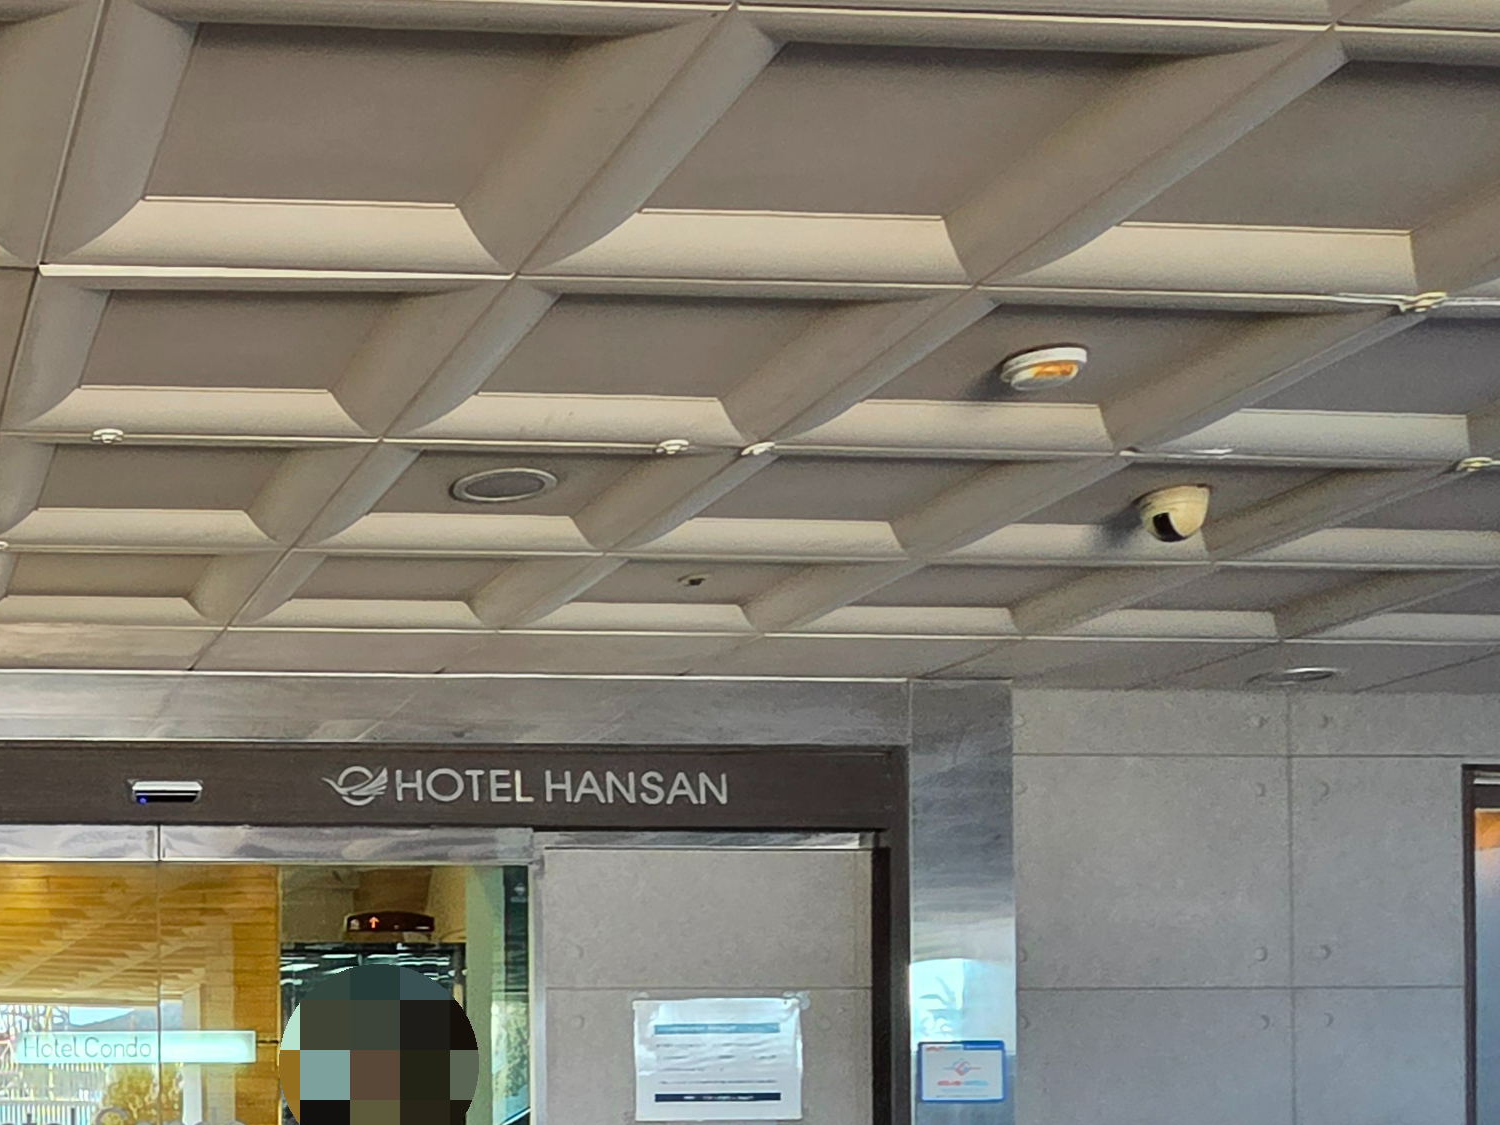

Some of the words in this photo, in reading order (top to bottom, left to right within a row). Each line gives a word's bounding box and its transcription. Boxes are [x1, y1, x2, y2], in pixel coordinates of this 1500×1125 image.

[396, 768, 535, 805] HOTEL
[544, 770, 729, 806] HANSAN
[23, 1036, 79, 1058] Hotel
[84, 1036, 152, 1058] Condo
